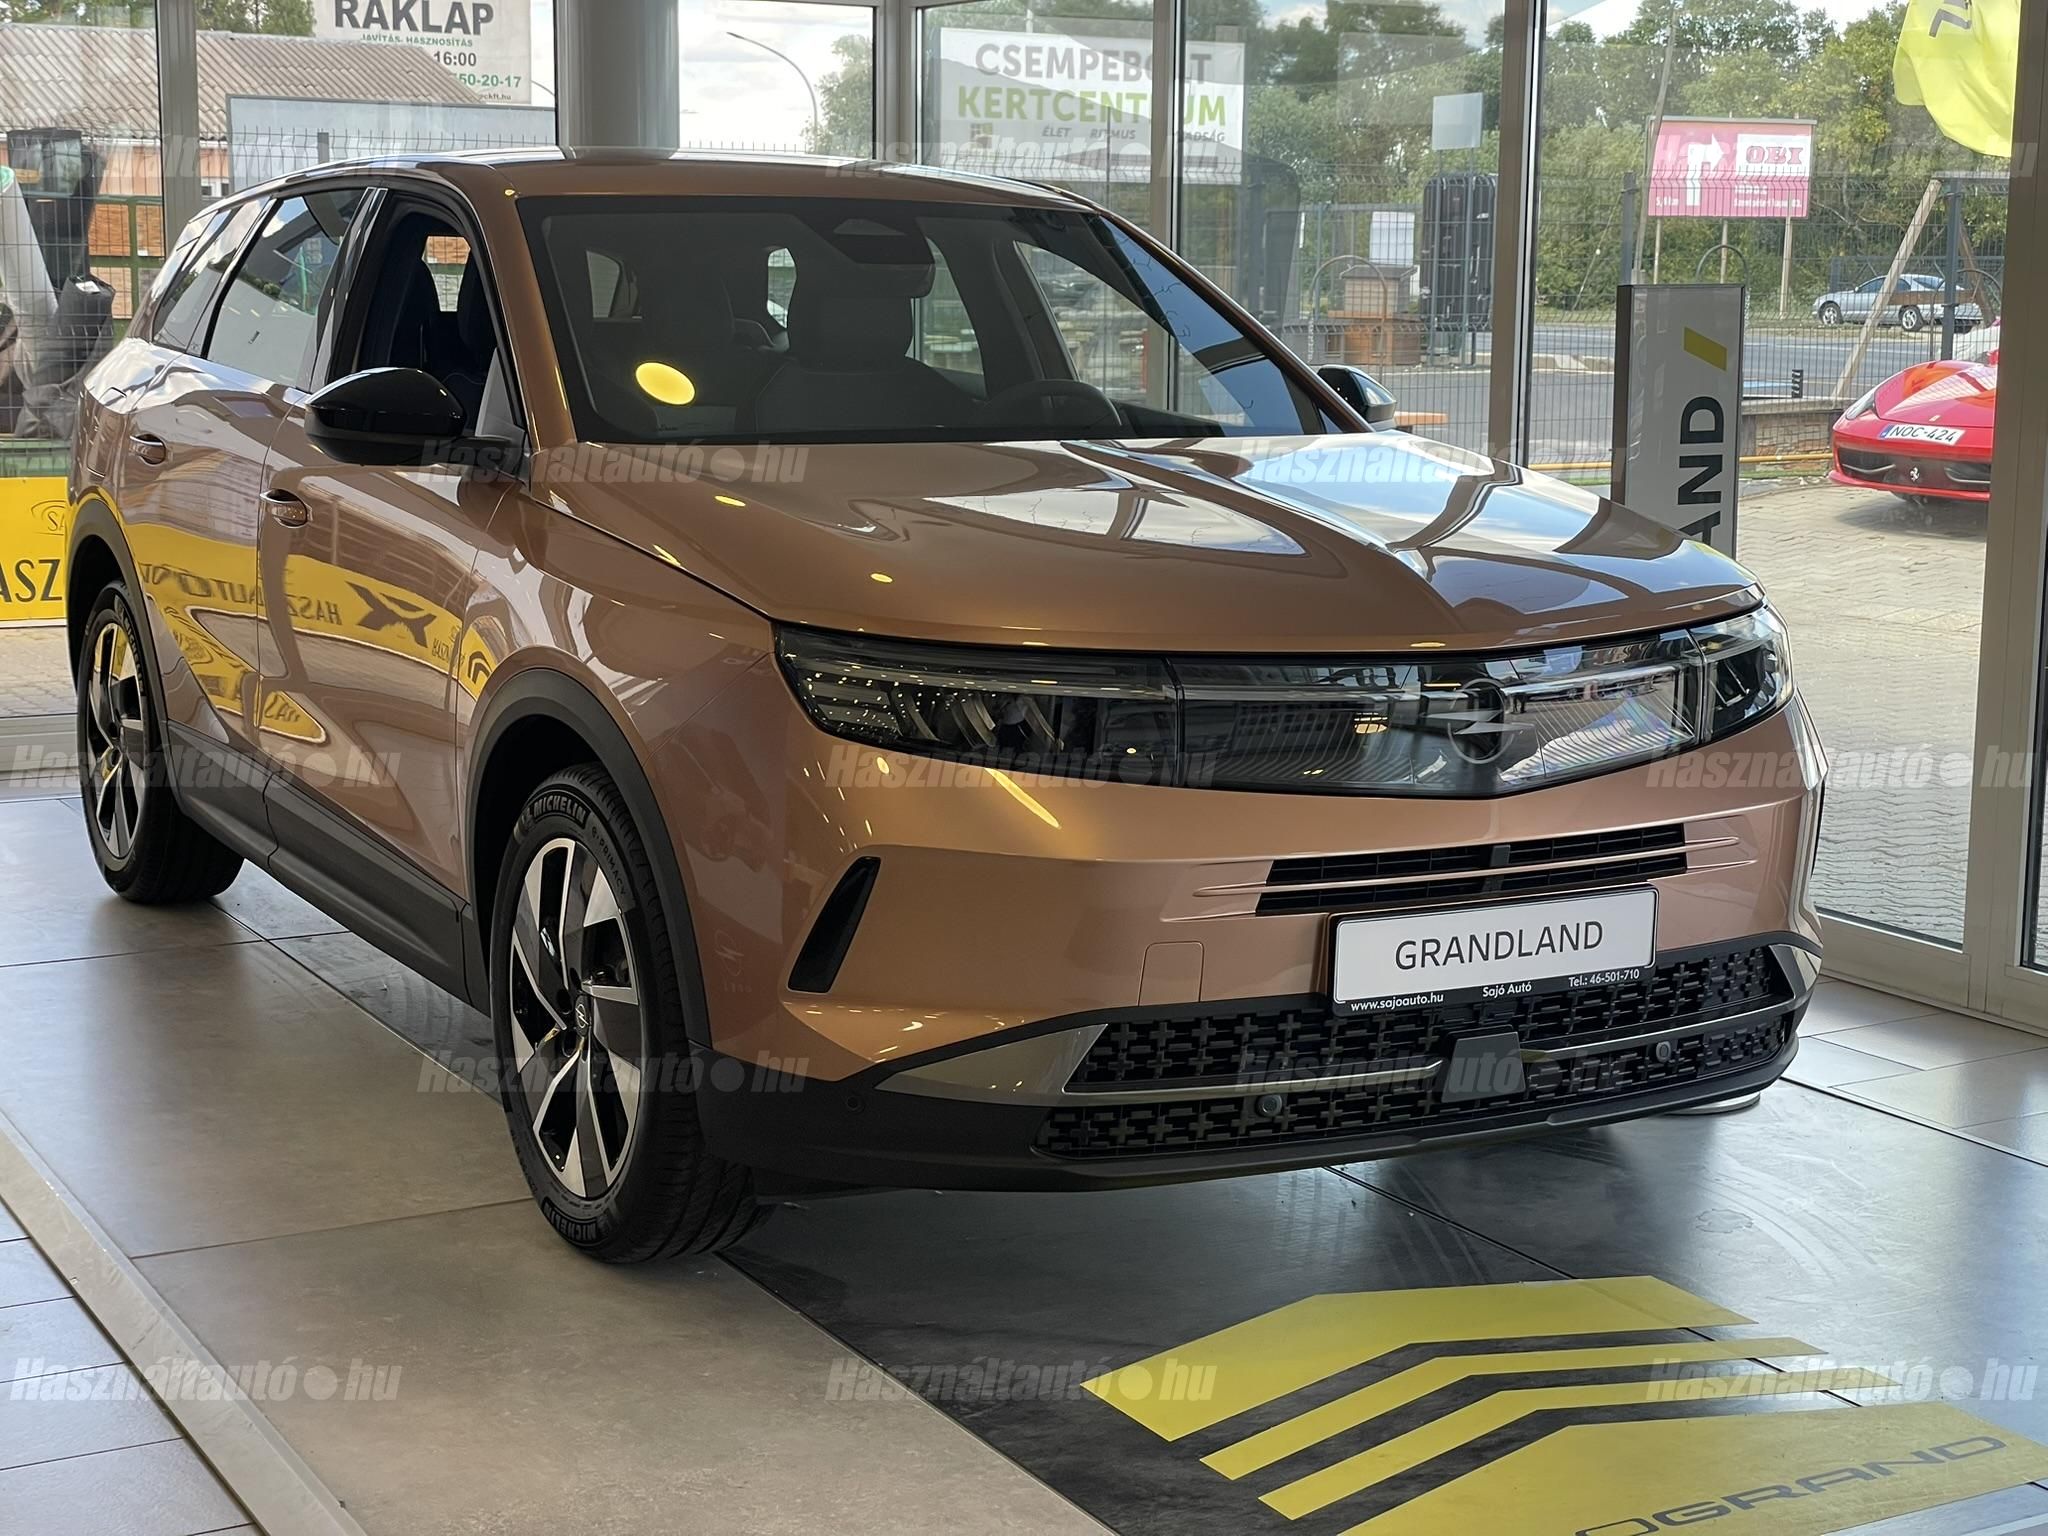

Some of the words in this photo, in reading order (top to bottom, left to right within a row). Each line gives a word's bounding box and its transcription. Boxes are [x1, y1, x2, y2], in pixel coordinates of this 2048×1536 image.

[335, 0, 494, 35] RAKLAP
[433, 51, 477, 66] 16:00
[975, 43, 1212, 84] CSEMPEBT
[958, 86, 1226, 127] KERTCENTUM
[1042, 125, 1072, 138] ÉLET
[1745, 145, 1803, 165] OBI
[1889, 426, 1957, 443] NOC-424
[534, 795, 587, 825] MICHELIN
[1395, 920, 1603, 970] GRANDLAND
[1350, 992, 1444, 1012] www.sajoauto.hu
[1483, 985, 1505, 998] Sajó
[1507, 981, 1532, 995] Autó
[1568, 975, 1588, 988] Tel.:
[1590, 968, 1640, 984] 46-501-710
